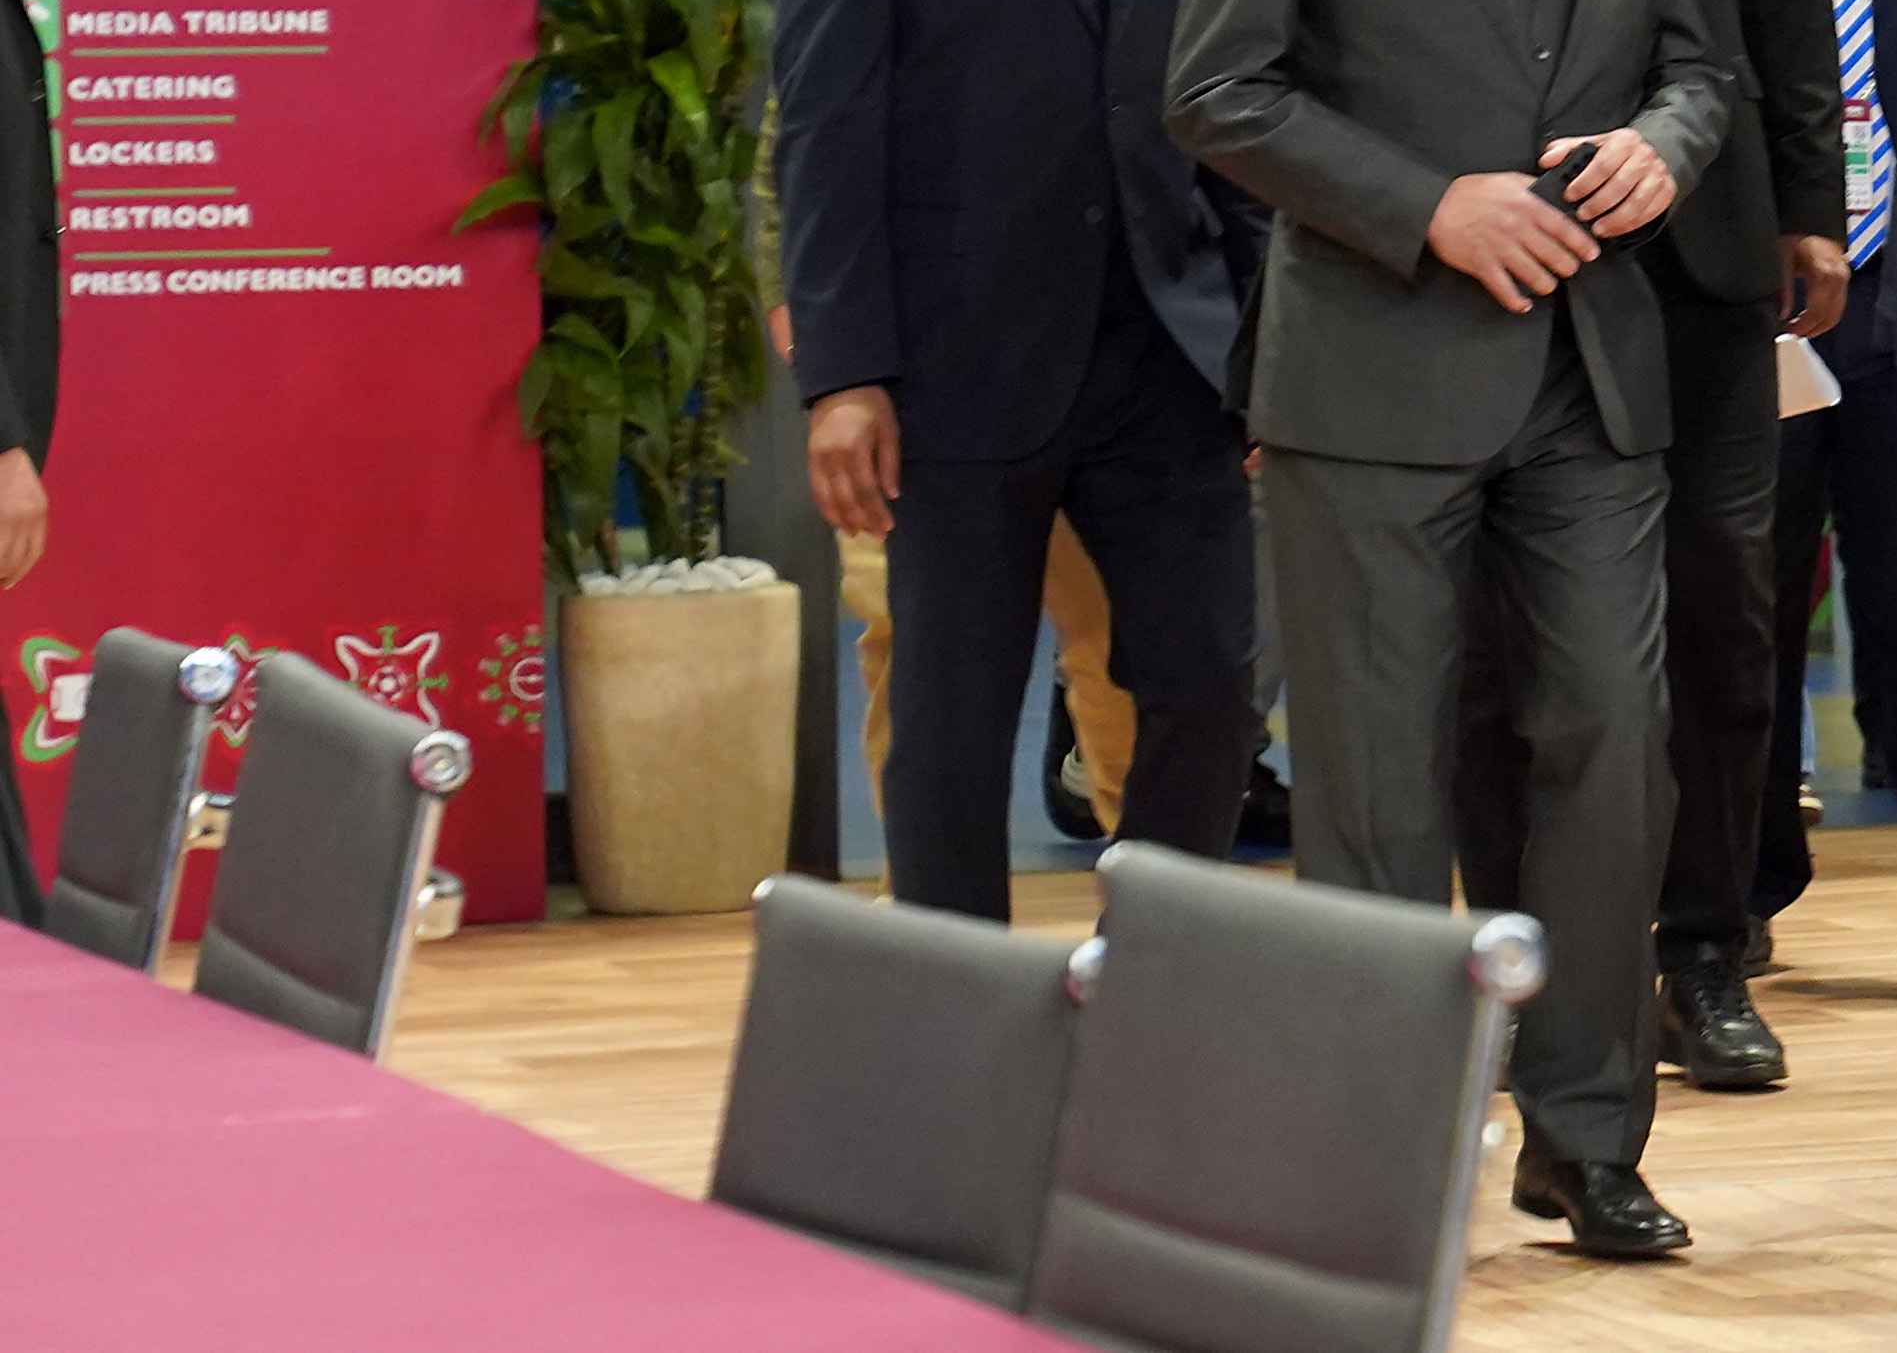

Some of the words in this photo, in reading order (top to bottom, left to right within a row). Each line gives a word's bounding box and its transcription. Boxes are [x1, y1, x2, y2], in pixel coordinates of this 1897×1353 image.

[67, 11, 175, 36] MEDIA
[181, 9, 329, 34] TRIBUNE
[67, 75, 236, 101] CATERING
[69, 140, 215, 167] LOCKERS
[69, 204, 250, 231] RESTROOM
[70, 271, 162, 296] PRESS
[166, 266, 366, 293] CONFERENCE
[371, 264, 462, 289] ROOM
